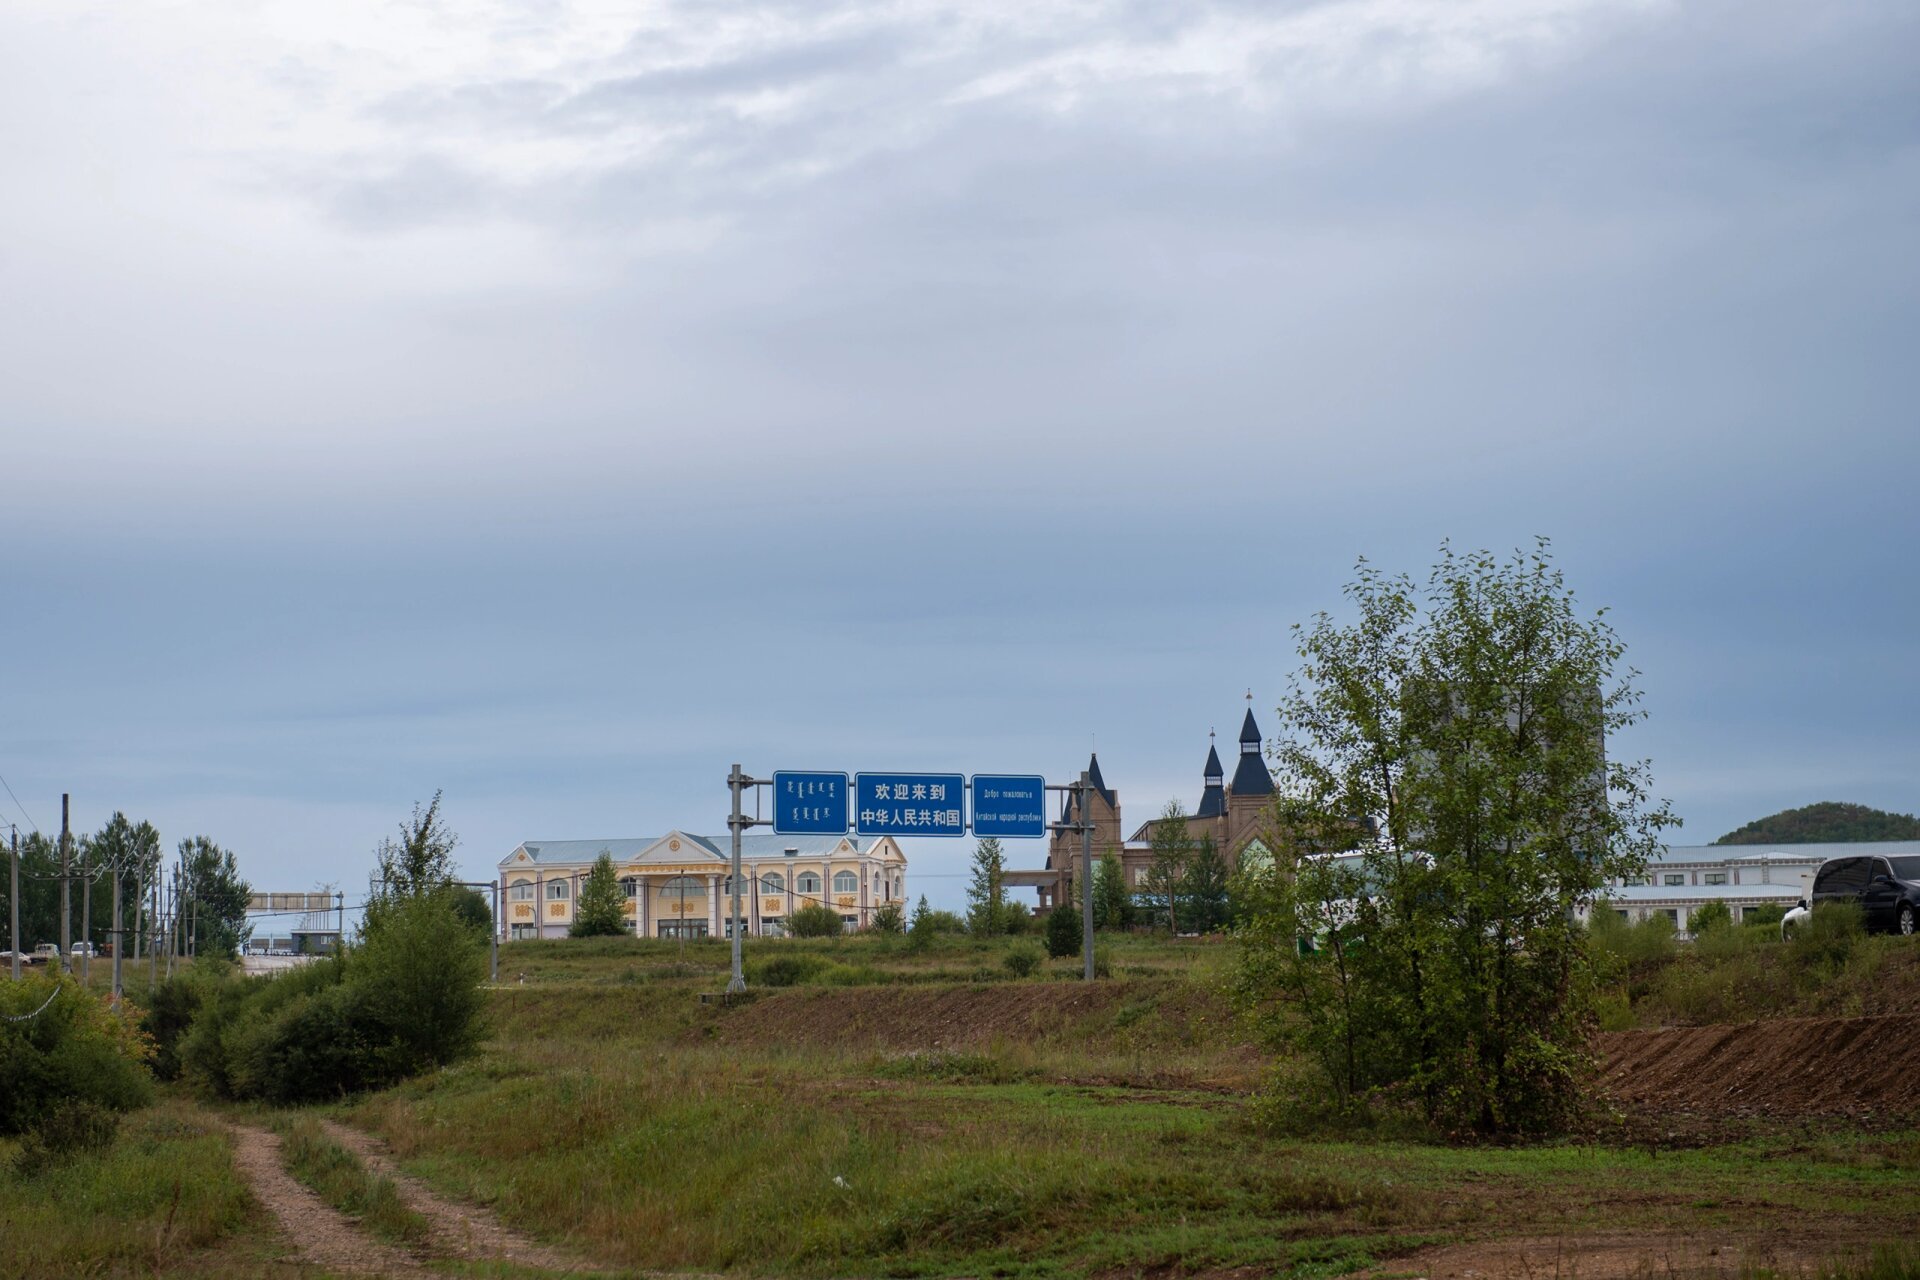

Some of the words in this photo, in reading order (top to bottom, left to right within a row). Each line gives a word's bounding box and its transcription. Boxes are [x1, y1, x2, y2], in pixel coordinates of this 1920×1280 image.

[875, 783, 946, 801] 欢迎来到
[984, 789, 999, 799] Добро
[861, 808, 960, 826] 中华人民共和国
